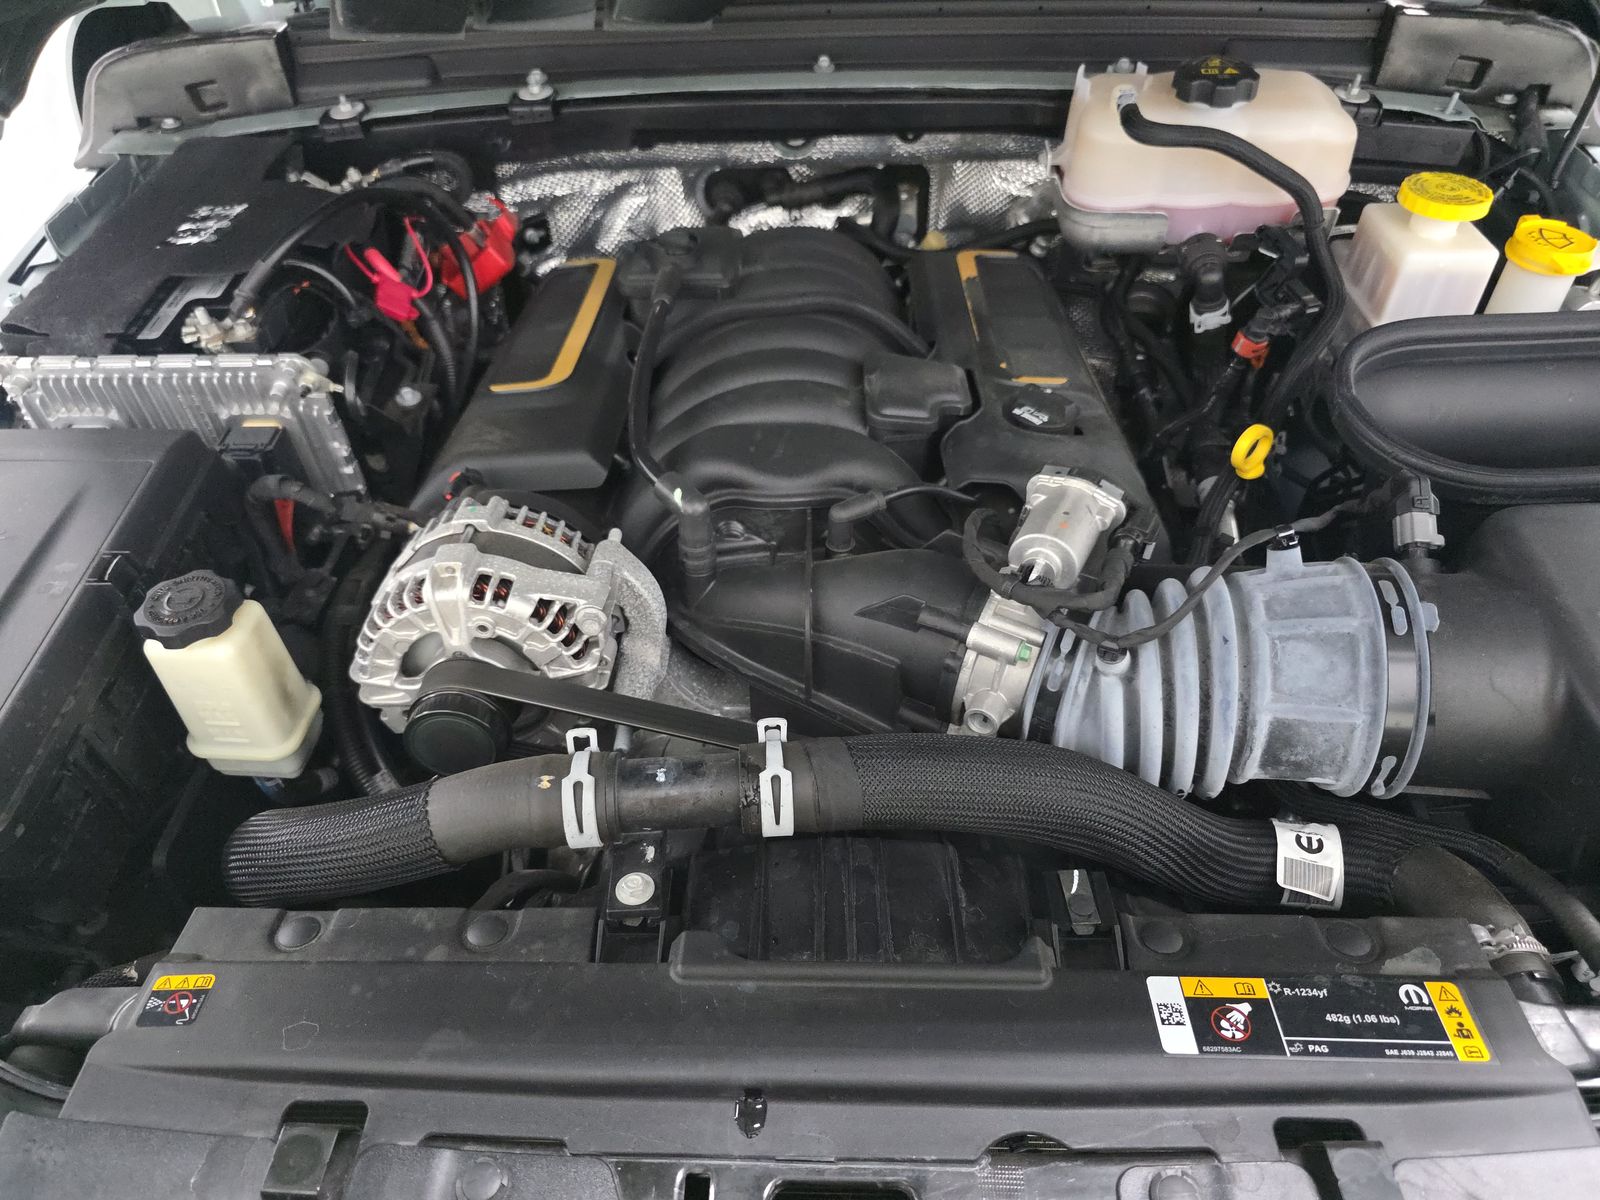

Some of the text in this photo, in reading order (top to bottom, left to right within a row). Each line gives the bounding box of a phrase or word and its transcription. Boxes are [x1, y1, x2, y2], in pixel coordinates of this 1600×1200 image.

[1283, 987, 1328, 999] R-1234yf
[1325, 1013, 1400, 1026] 482g (1.06 lbs)
[1307, 1044, 1330, 1053] PAG
